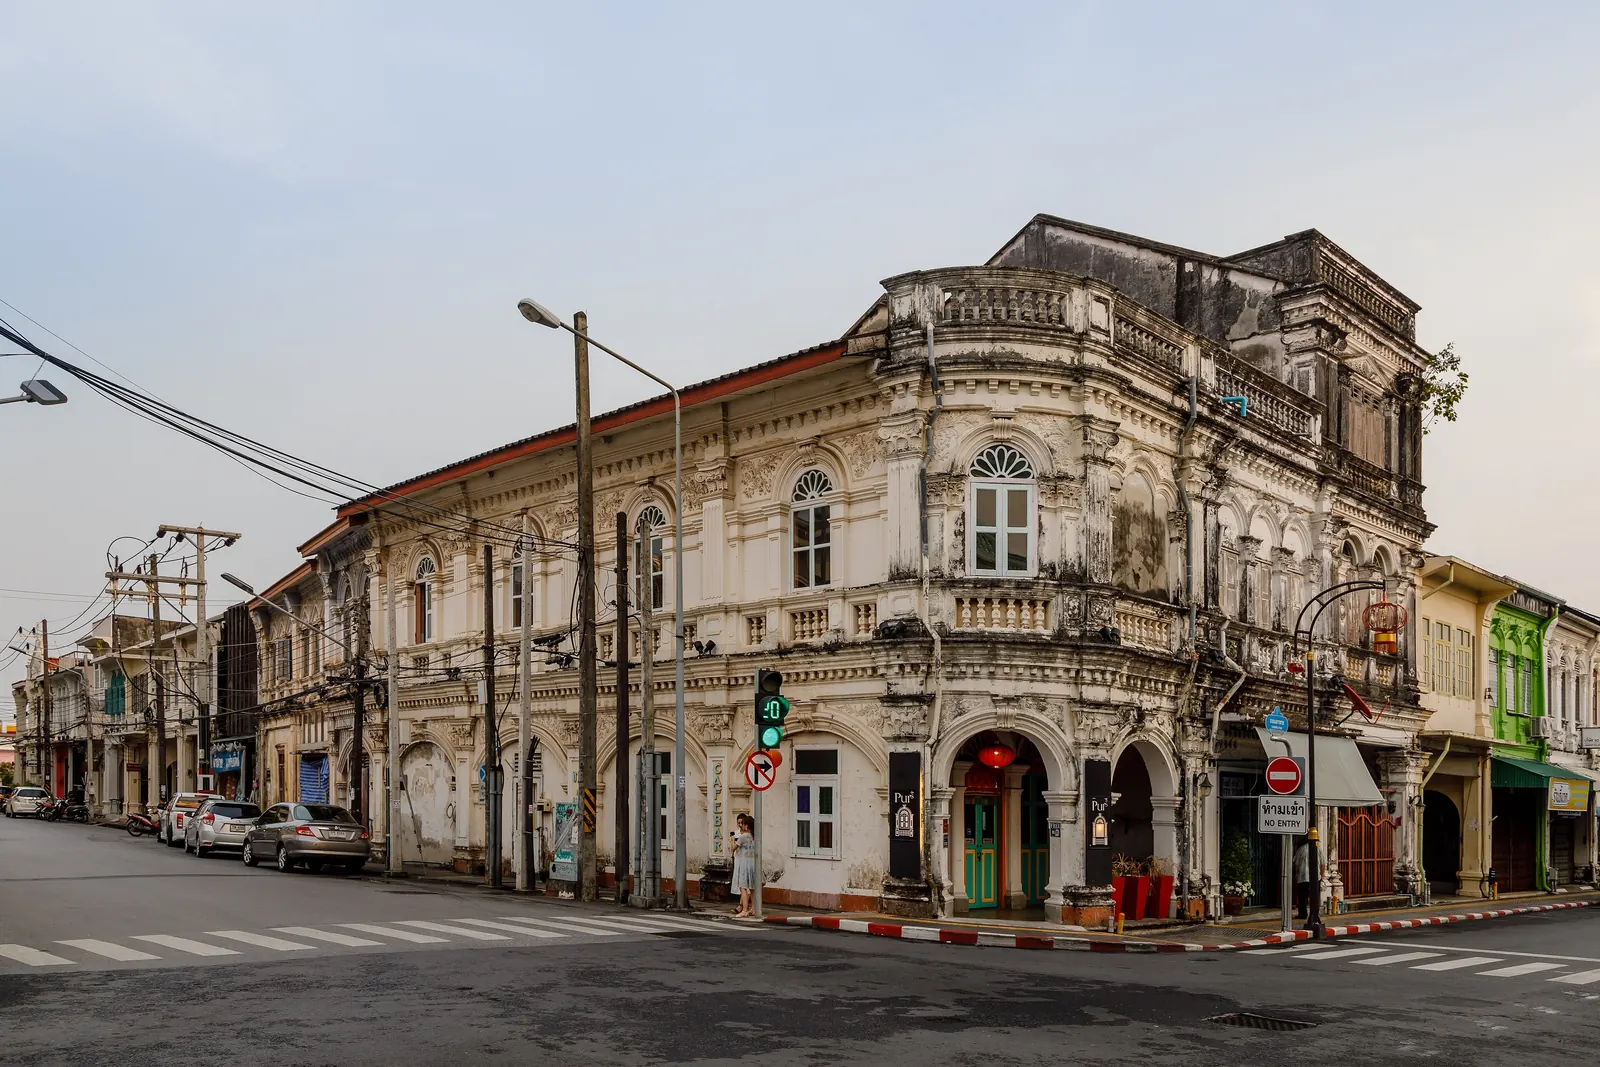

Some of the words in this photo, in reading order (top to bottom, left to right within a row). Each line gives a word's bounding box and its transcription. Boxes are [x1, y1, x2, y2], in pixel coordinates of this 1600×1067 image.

[1262, 800, 1304, 815] ห้ามเข้า
[1264, 819, 1275, 827] NO
[1277, 819, 1301, 827] ENTRY
